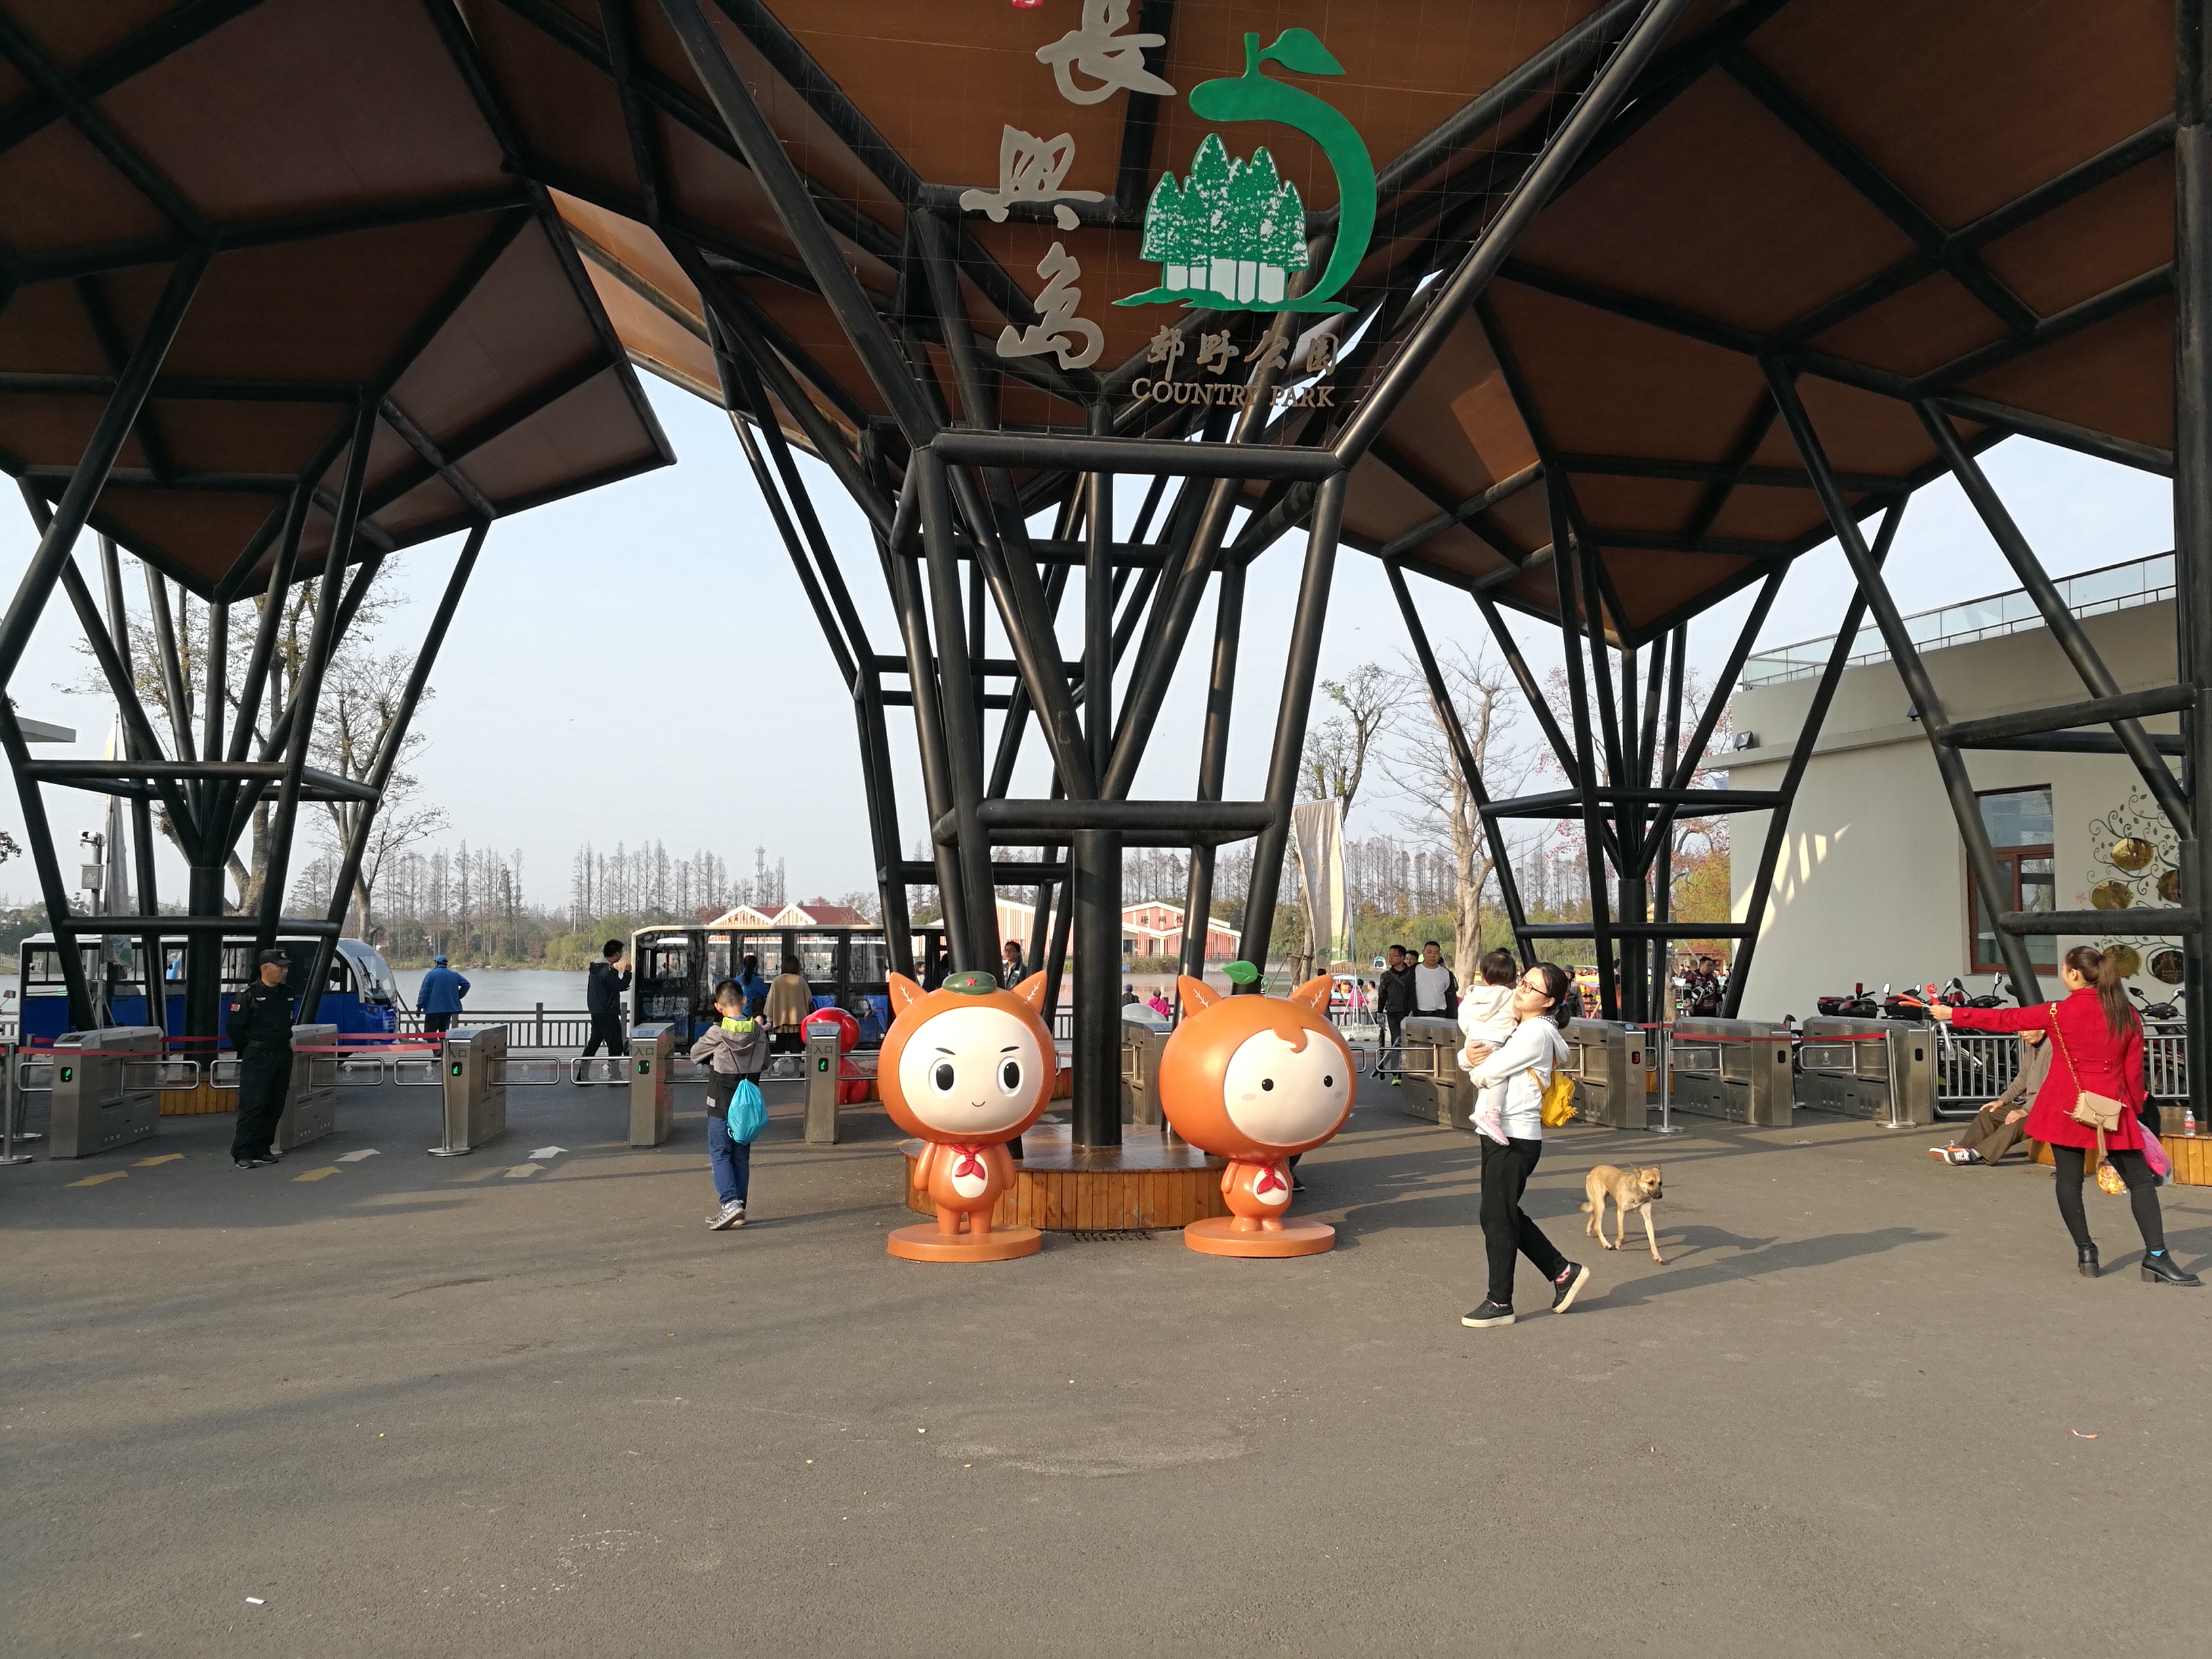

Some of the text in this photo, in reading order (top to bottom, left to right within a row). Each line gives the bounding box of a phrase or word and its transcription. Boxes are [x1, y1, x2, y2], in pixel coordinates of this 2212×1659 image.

[1132, 377, 1336, 408] COUNTRY PARK
[449, 1049, 467, 1058] 入口
[634, 1047, 654, 1056] 入口
[813, 1045, 833, 1054] 入口
